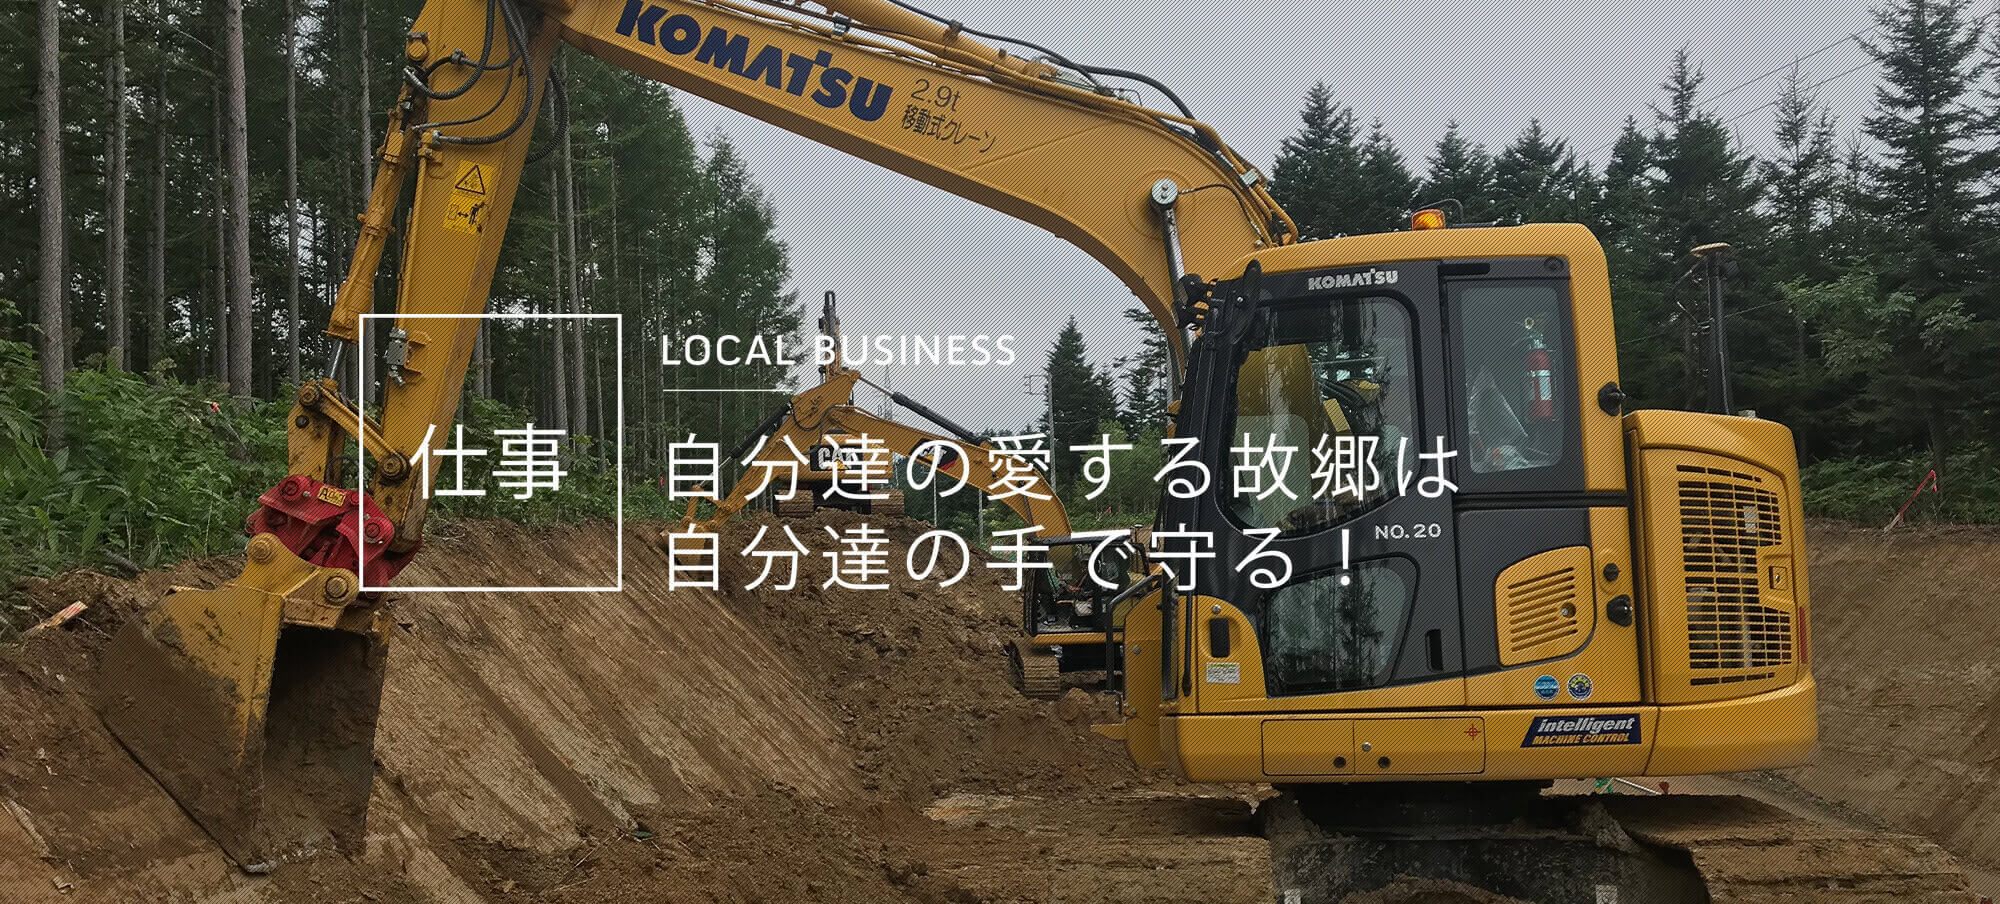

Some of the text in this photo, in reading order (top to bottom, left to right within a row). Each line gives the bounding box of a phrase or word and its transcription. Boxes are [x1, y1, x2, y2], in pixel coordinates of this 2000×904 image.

[615, 0, 893, 123] KOMATSU
[911, 78, 961, 112] 2.9t
[901, 104, 997, 154] 移動式クレーン
[1308, 268, 1398, 290] KOMATSU
[1375, 523, 1441, 539] NO. 20
[1537, 717, 1635, 734] intelligent
[1532, 733, 1630, 745] MACHINE CONTROL
